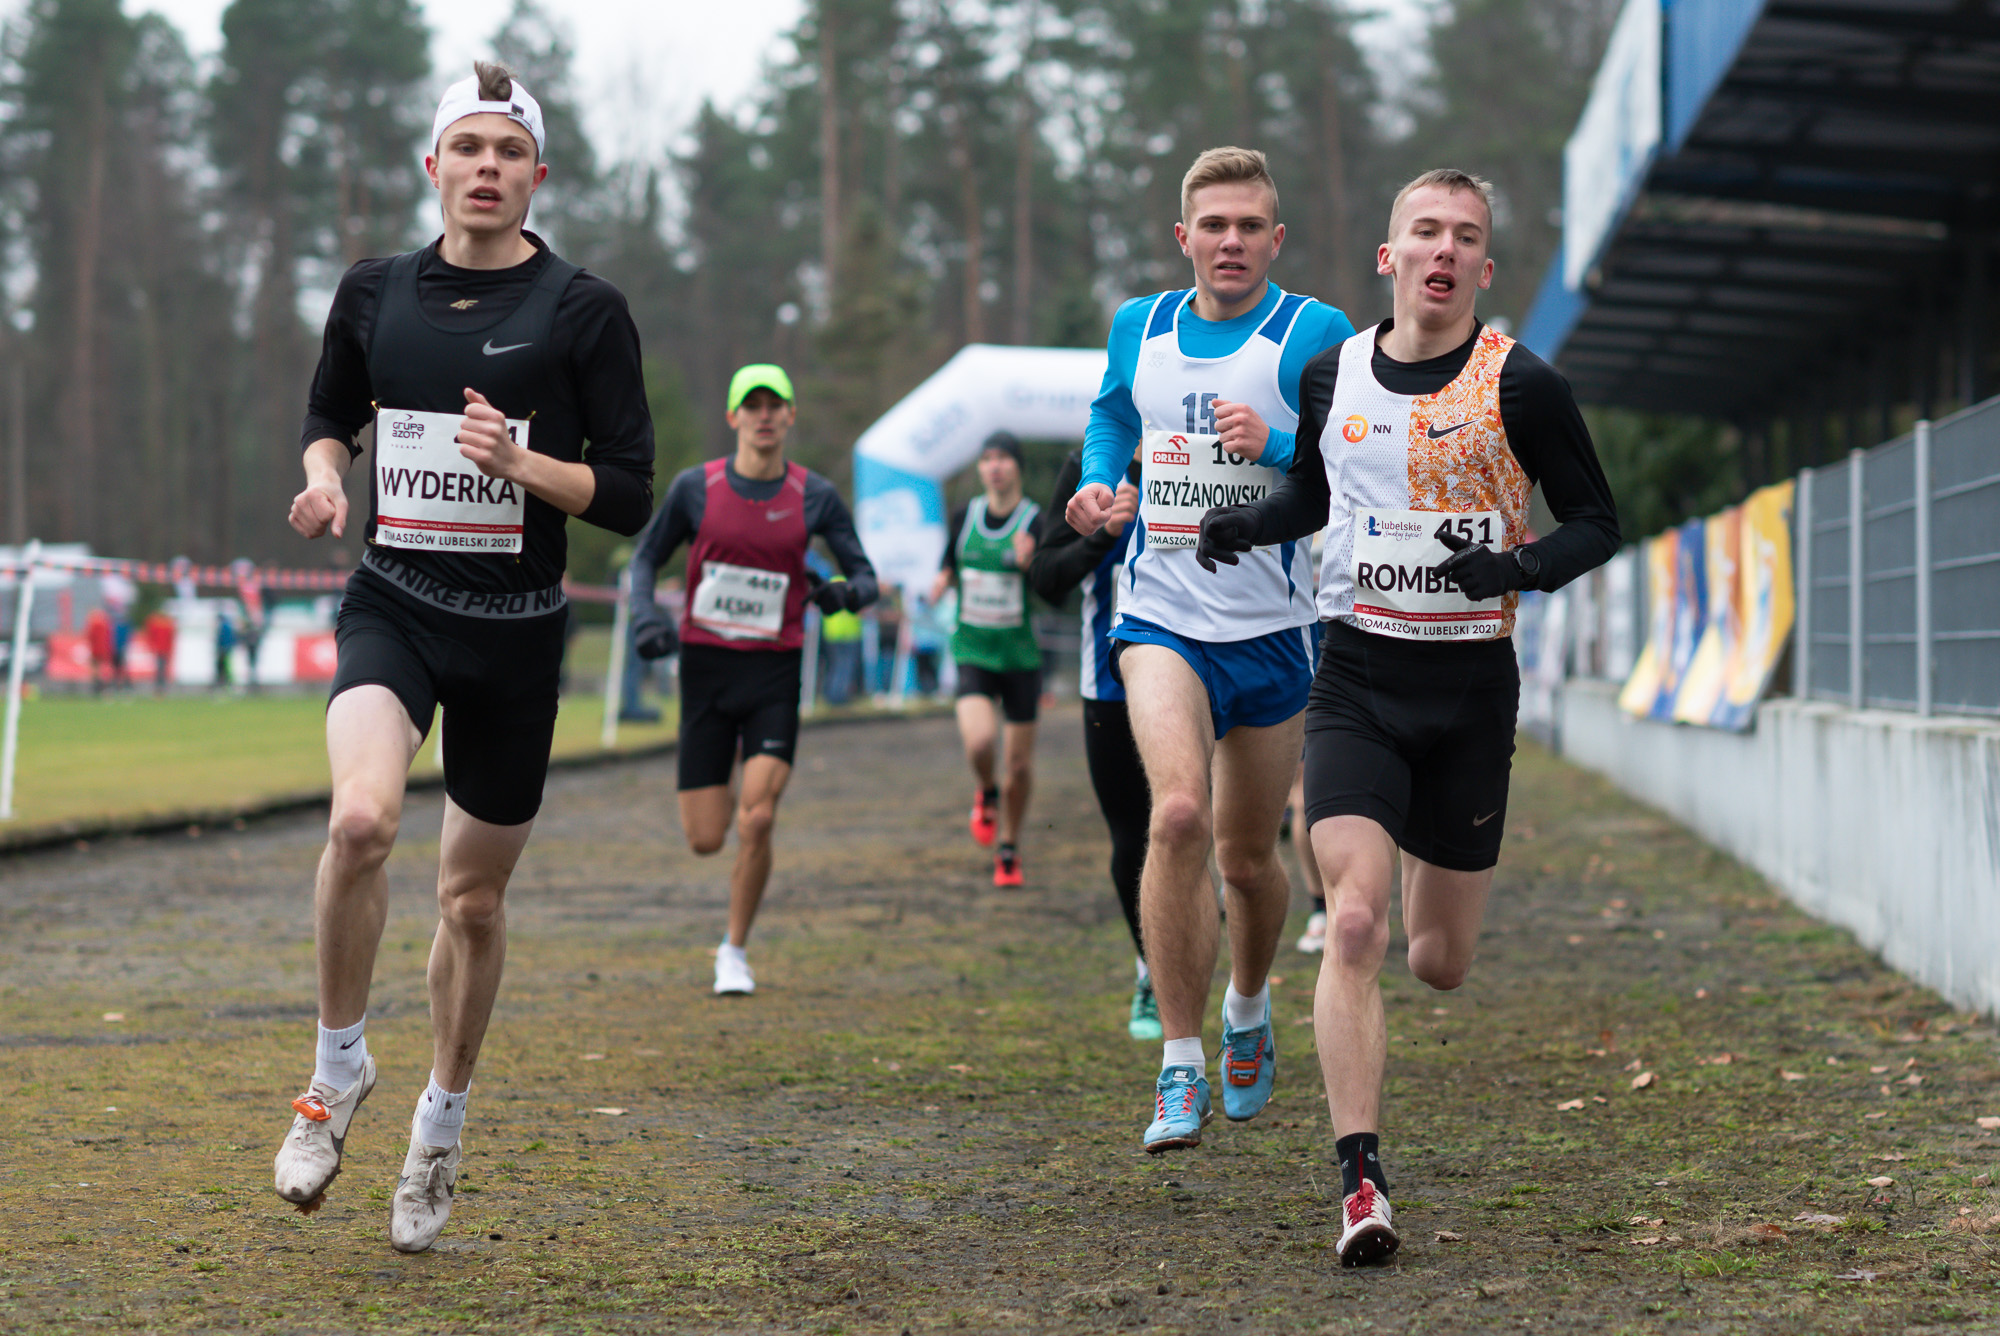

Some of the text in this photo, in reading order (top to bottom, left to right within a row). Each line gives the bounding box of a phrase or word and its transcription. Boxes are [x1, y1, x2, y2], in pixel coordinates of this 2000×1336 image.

[450, 299, 479, 309] 4F
[1372, 424, 1392, 434] NN
[1154, 453, 1189, 464] ORLEN
[381, 466, 518, 505] WYDERKA
[1147, 474, 1267, 508] KRZYŻANOWSKI
[1381, 520, 1422, 532] lubelskie
[1433, 517, 1494, 544] 451
[384, 530, 516, 548] TOMASZÓW LUBELSKI 2021
[396, 565, 463, 608] NIKE
[462, 591, 528, 615] PRO
[1360, 617, 1497, 636] TOMASZÓW LUBELSKI 2021
